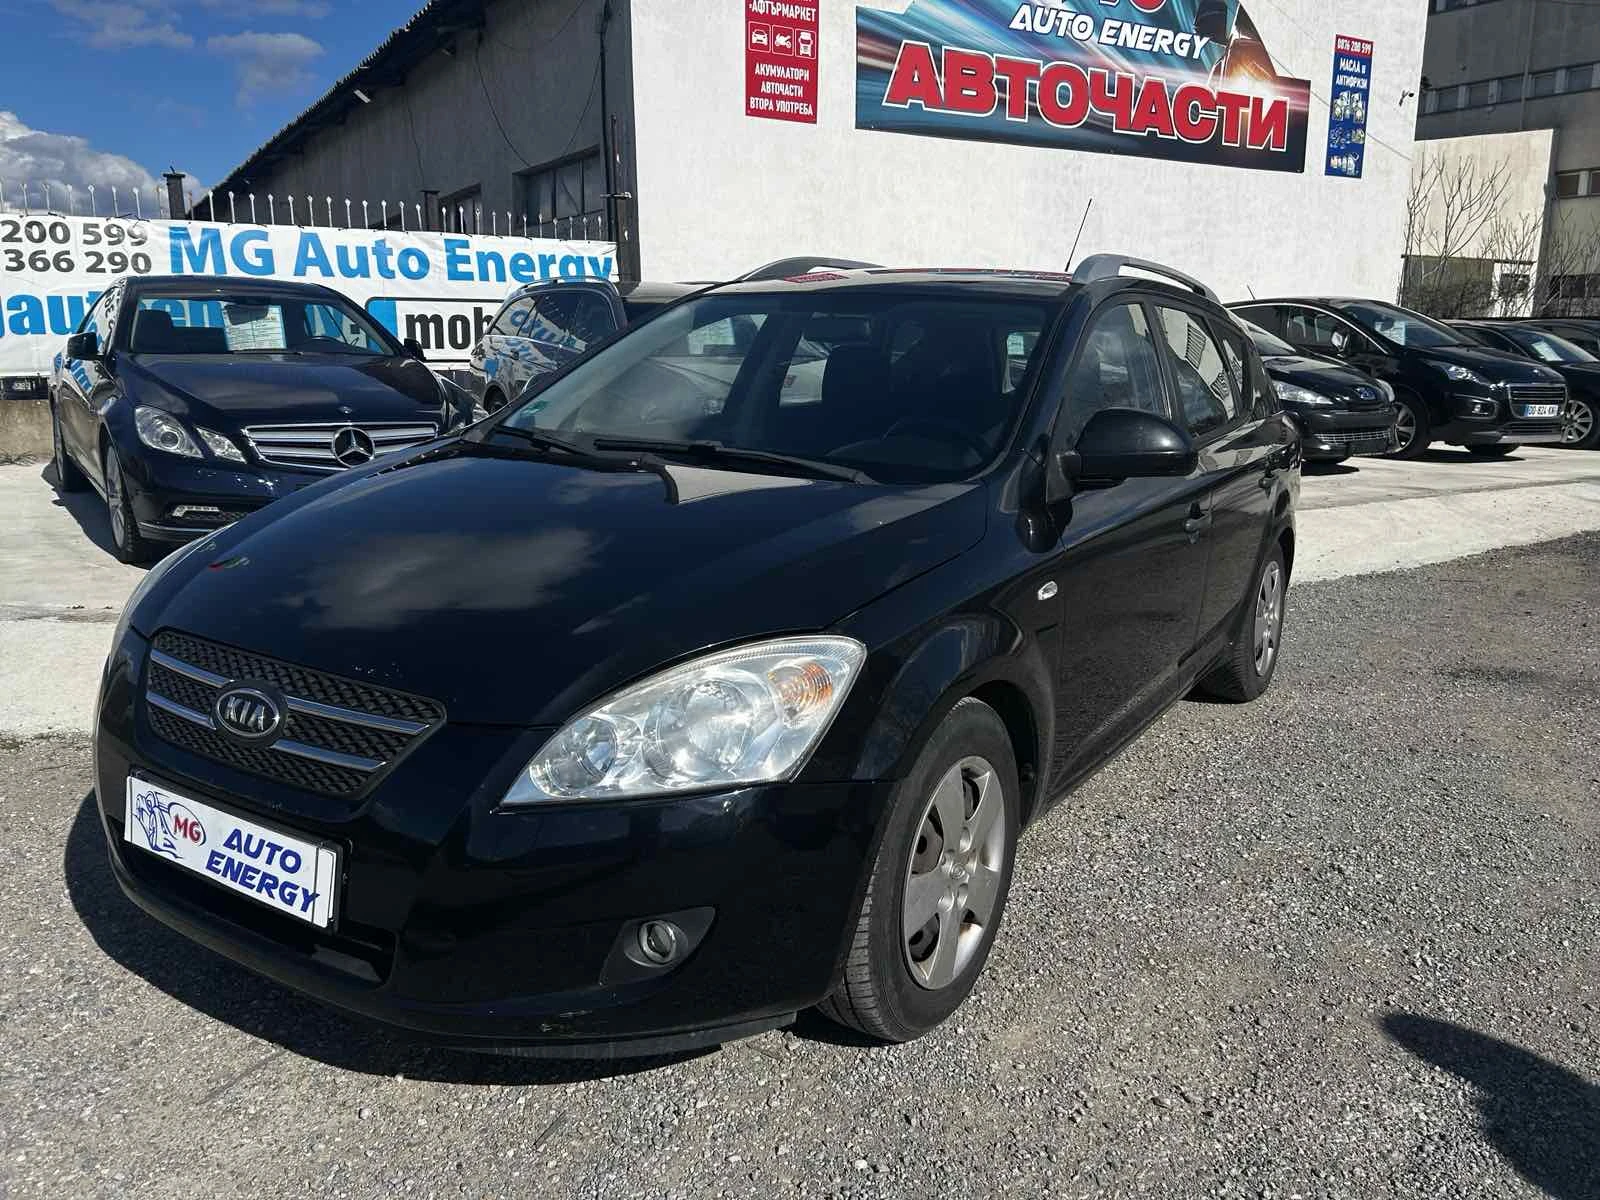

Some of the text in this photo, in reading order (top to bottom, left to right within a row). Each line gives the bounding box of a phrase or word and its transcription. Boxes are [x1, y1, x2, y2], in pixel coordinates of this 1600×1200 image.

[1009, 3, 1210, 59] AUTO ENERGY
[755, 62, 809, 81] АКУМУЛАТОРИ
[761, 81, 803, 97] АВТОЧАСТИ
[750, 96, 814, 116] ВТОРА УПОТРЕБА
[882, 41, 1289, 152] АВТОЧАСТИ
[0, 220, 149, 246] 200 599
[4, 248, 152, 274] 366 290
[168, 226, 276, 276] MG
[293, 232, 431, 281] Auto
[173, 813, 302, 875] MG AUTO
[205, 848, 320, 914] ENERGY
